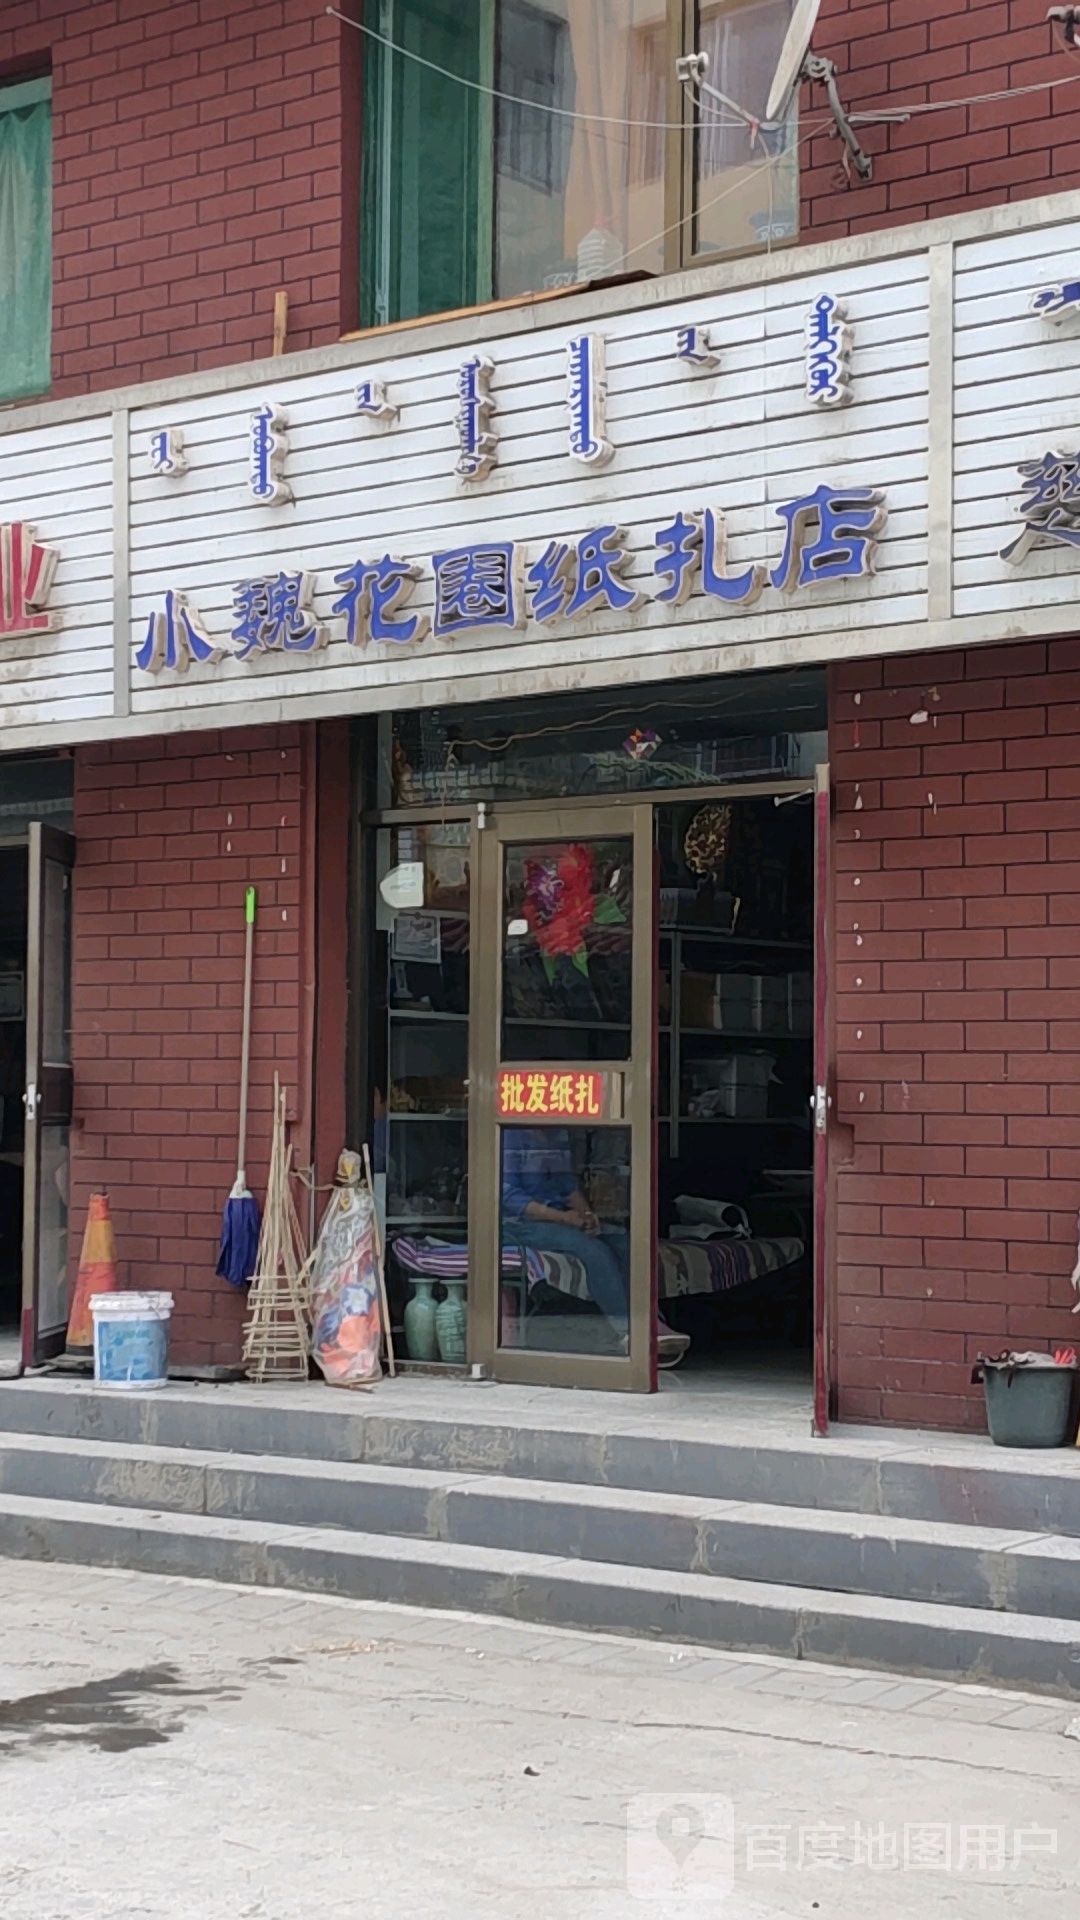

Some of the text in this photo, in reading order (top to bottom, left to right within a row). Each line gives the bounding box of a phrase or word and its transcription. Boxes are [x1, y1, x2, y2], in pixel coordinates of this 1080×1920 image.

[136, 484, 885, 673] 小魏花圈纸扎店
[501, 1072, 599, 1114] 批发纸扎
